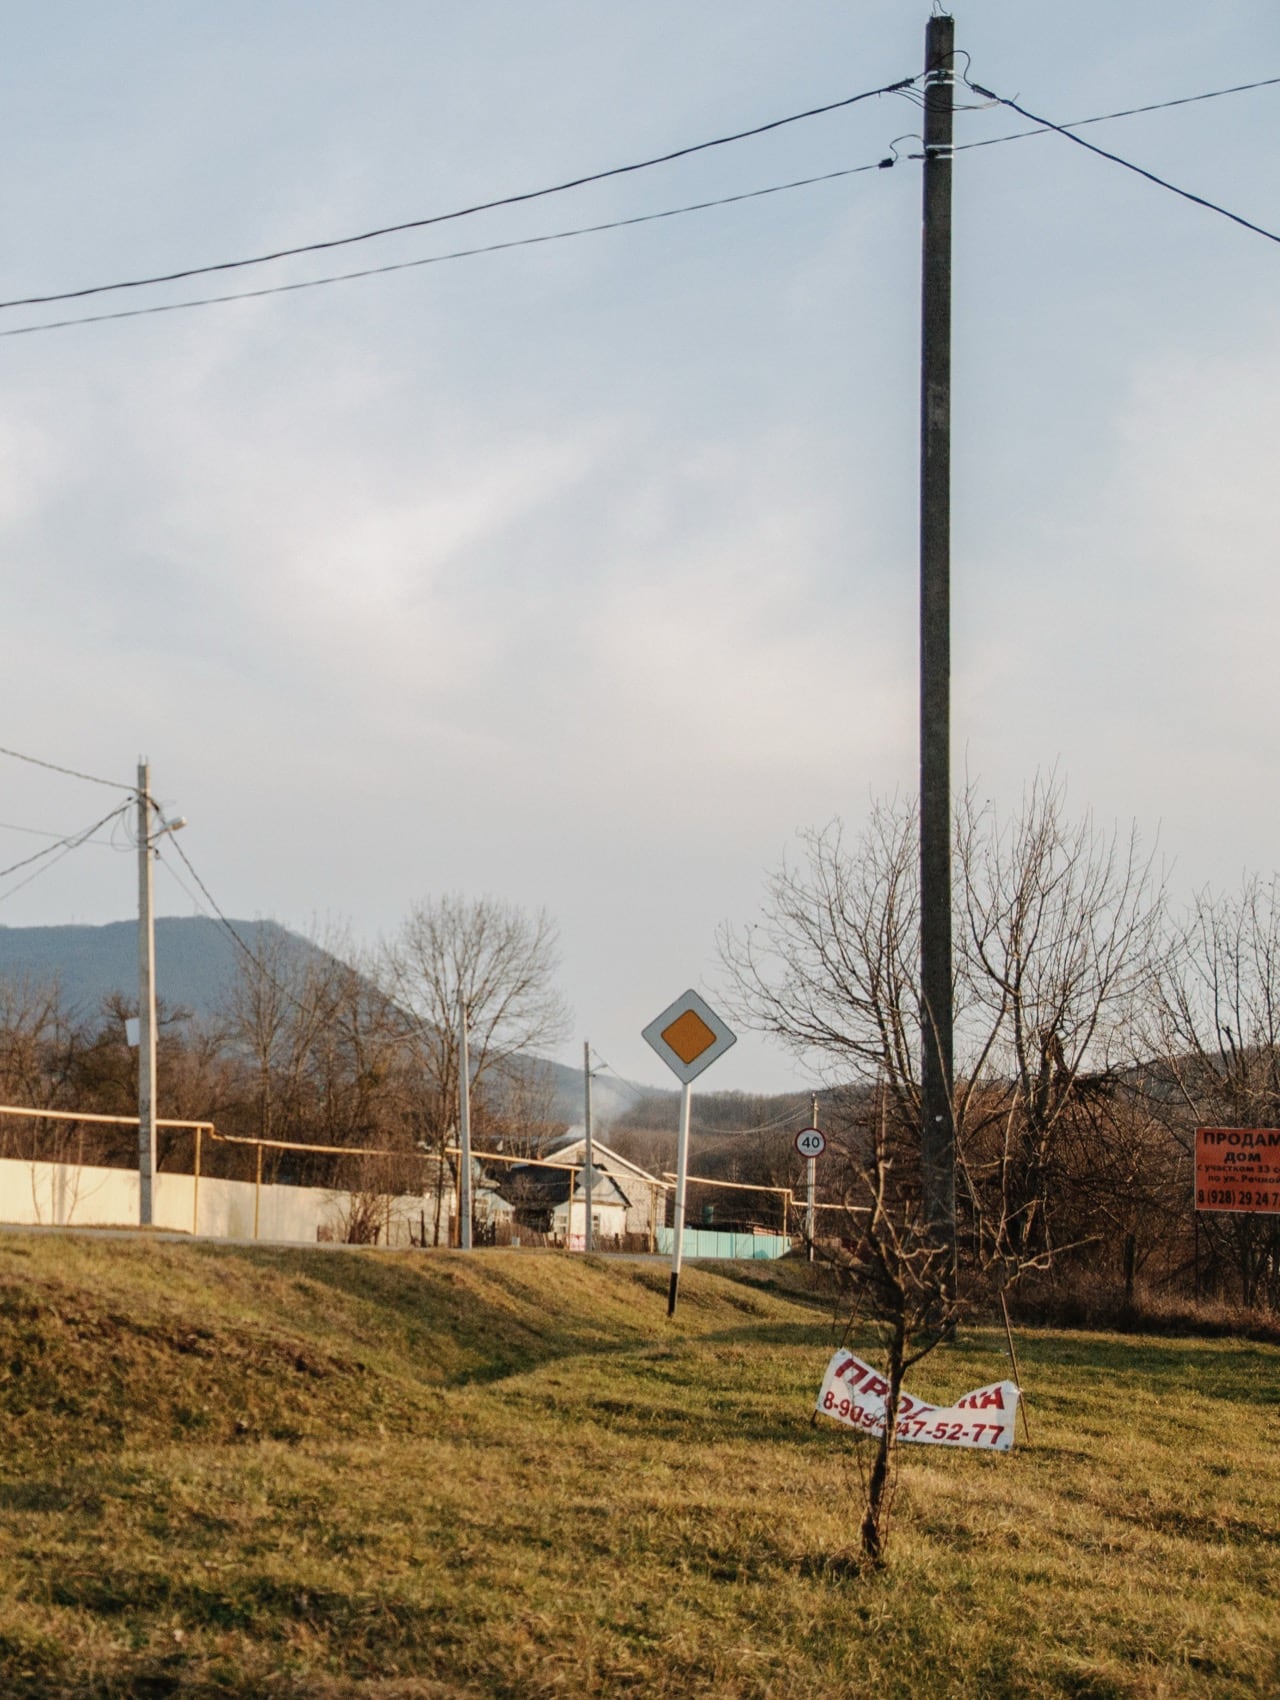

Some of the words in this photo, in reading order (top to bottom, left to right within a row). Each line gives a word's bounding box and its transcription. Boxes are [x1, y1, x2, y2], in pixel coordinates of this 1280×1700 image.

[801, 1136, 820, 1149] 40
[1203, 1132, 1280, 1148] ПРОДАМ
[1205, 1164, 1254, 1173] участком
[1198, 1189, 1205, 1204] 8
[1208, 1189, 1236, 1206] (928)
[1239, 1190, 1252, 1205] 29
[1255, 1191, 1269, 1206] 24
